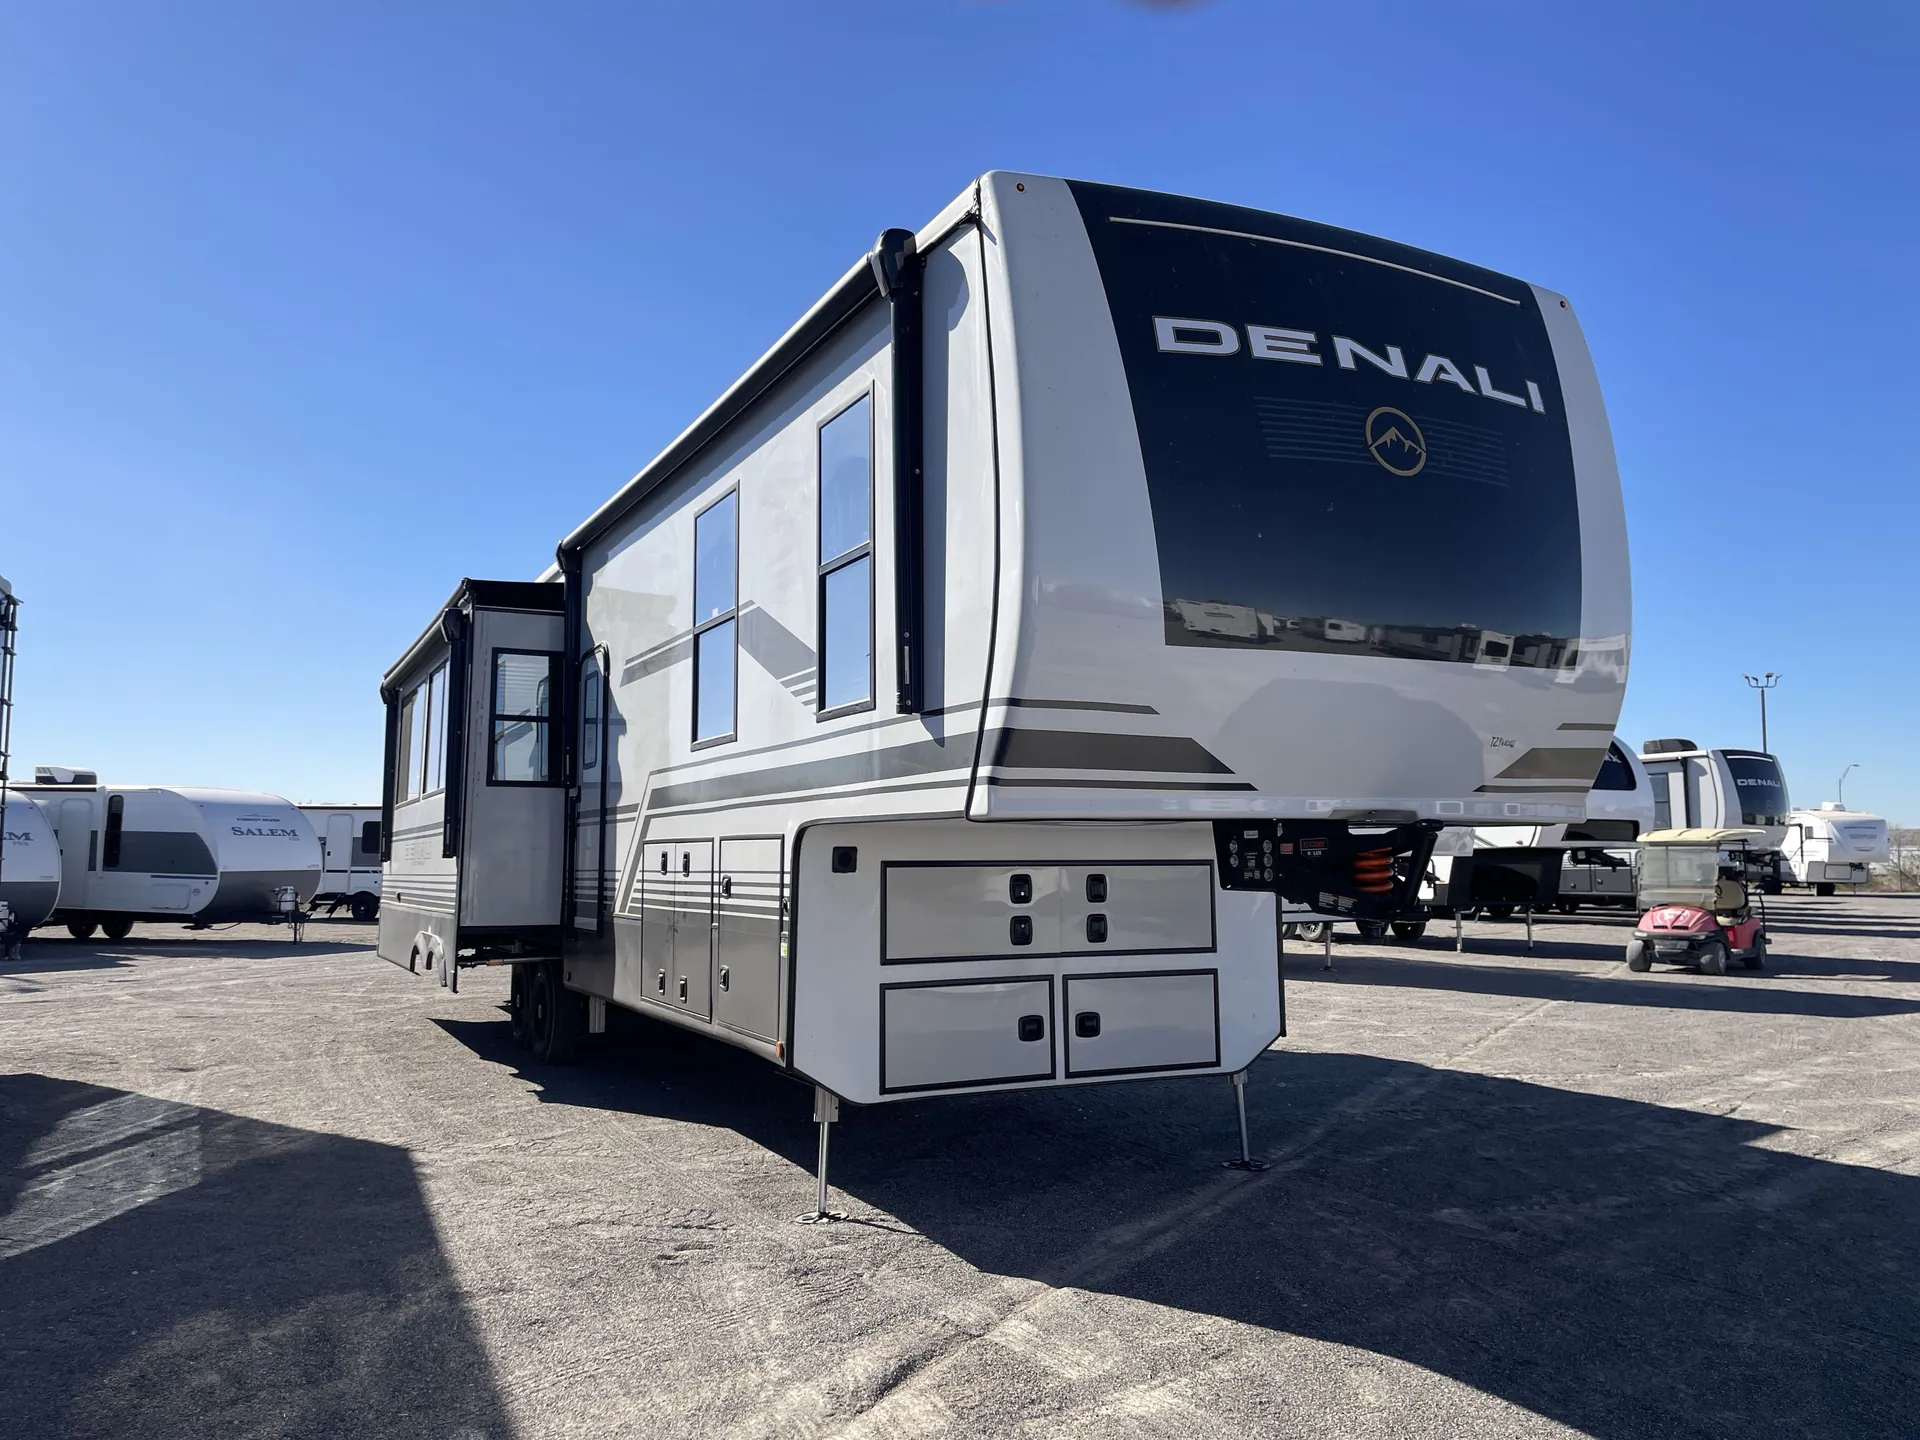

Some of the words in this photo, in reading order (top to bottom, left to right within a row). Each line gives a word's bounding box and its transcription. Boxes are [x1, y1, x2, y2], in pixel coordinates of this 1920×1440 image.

[1152, 314, 1546, 414] DENALI
[1736, 777, 1782, 788] DENALI
[231, 826, 299, 837] SALEM
